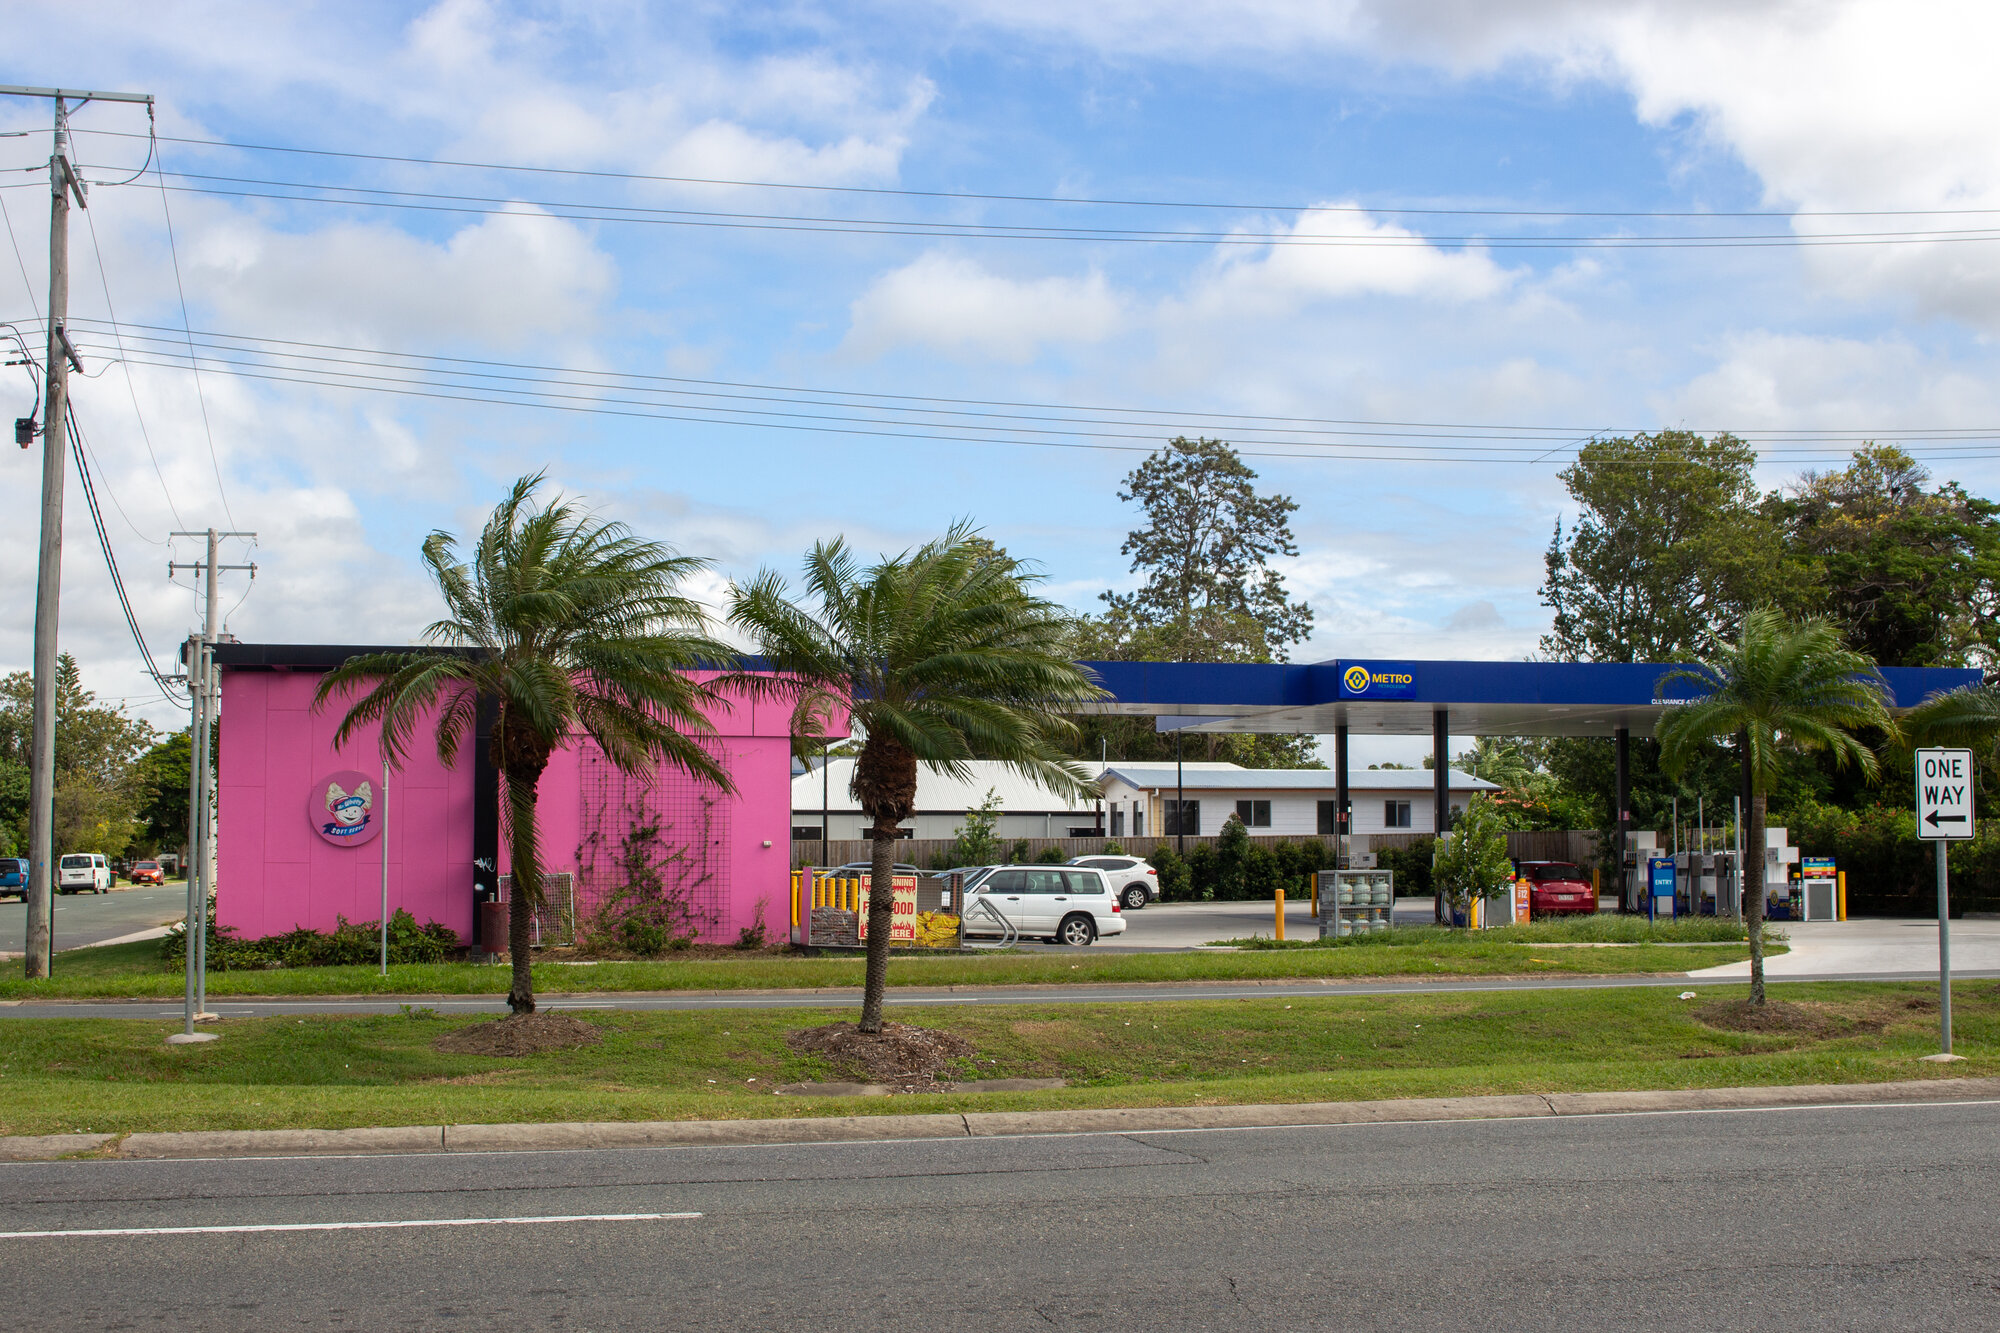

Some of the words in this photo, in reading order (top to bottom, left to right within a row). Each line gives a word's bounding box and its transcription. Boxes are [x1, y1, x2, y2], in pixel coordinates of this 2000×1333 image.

[1372, 673, 1413, 684] METRO
[1925, 759, 1963, 778] ONE
[1924, 786, 1965, 805] WAY
[330, 827, 348, 835] SOFT
[348, 824, 365, 834] SERVE
